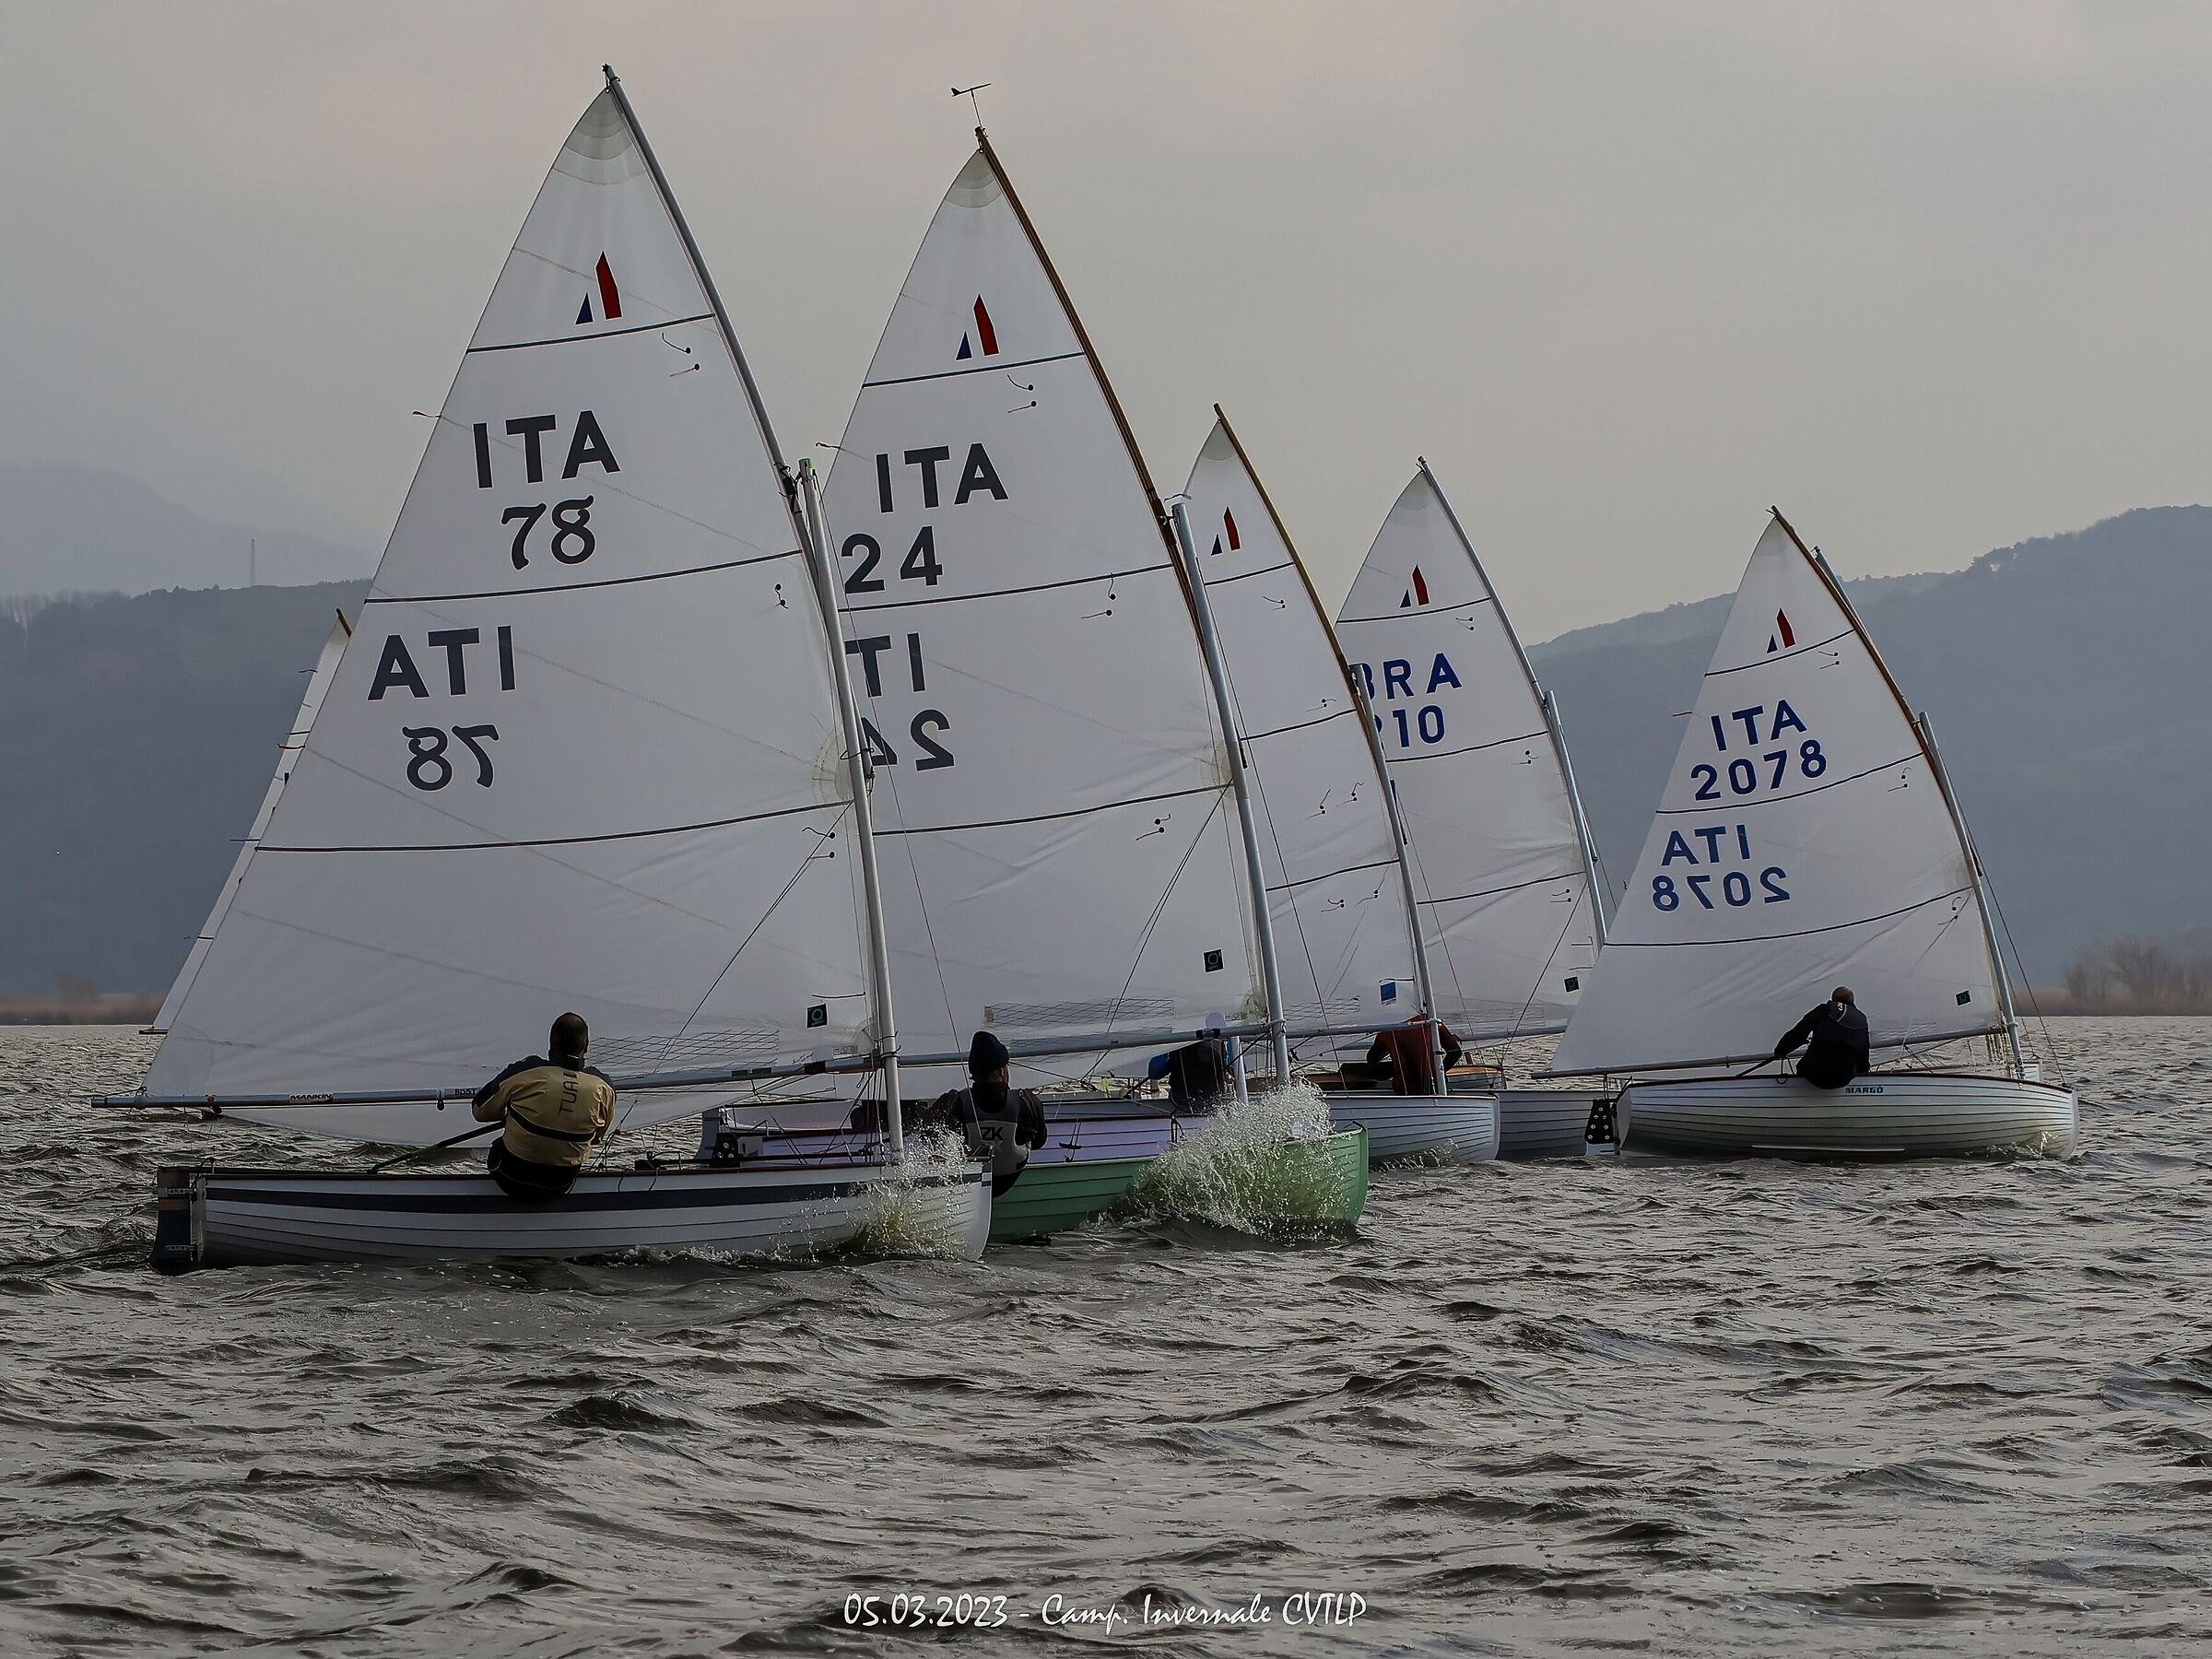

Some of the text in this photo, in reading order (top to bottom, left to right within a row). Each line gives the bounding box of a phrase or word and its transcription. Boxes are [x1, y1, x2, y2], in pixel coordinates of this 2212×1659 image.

[472, 409, 621, 489] ITA
[875, 442, 1009, 514] ITA
[500, 495, 595, 571] 78
[841, 525, 943, 593] 24
[1374, 704, 1445, 748] 10
[1710, 699, 1807, 752] ITA
[1690, 739, 1827, 801] 2078
